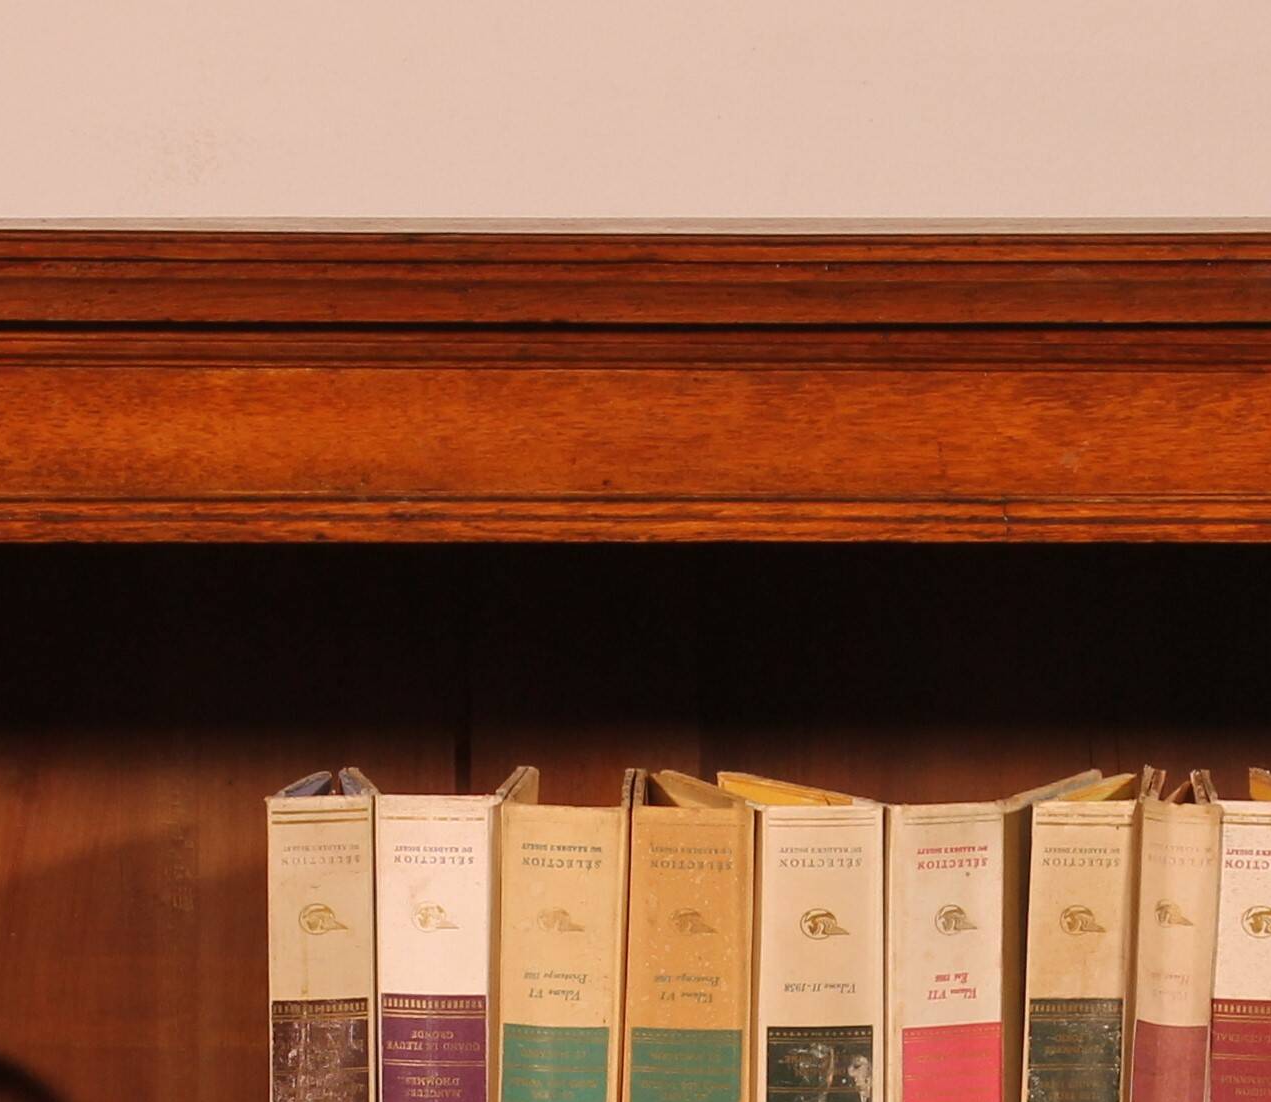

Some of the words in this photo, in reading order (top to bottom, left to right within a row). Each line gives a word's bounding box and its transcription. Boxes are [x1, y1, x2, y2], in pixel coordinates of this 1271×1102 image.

[393, 855, 474, 867] SÉLECTION
[522, 855, 602, 870] SÉLECTION
[779, 857, 862, 870] SÉLECTION
[917, 857, 988, 870] SÉLECTION
[1042, 856, 1121, 869] SÉLECTION
